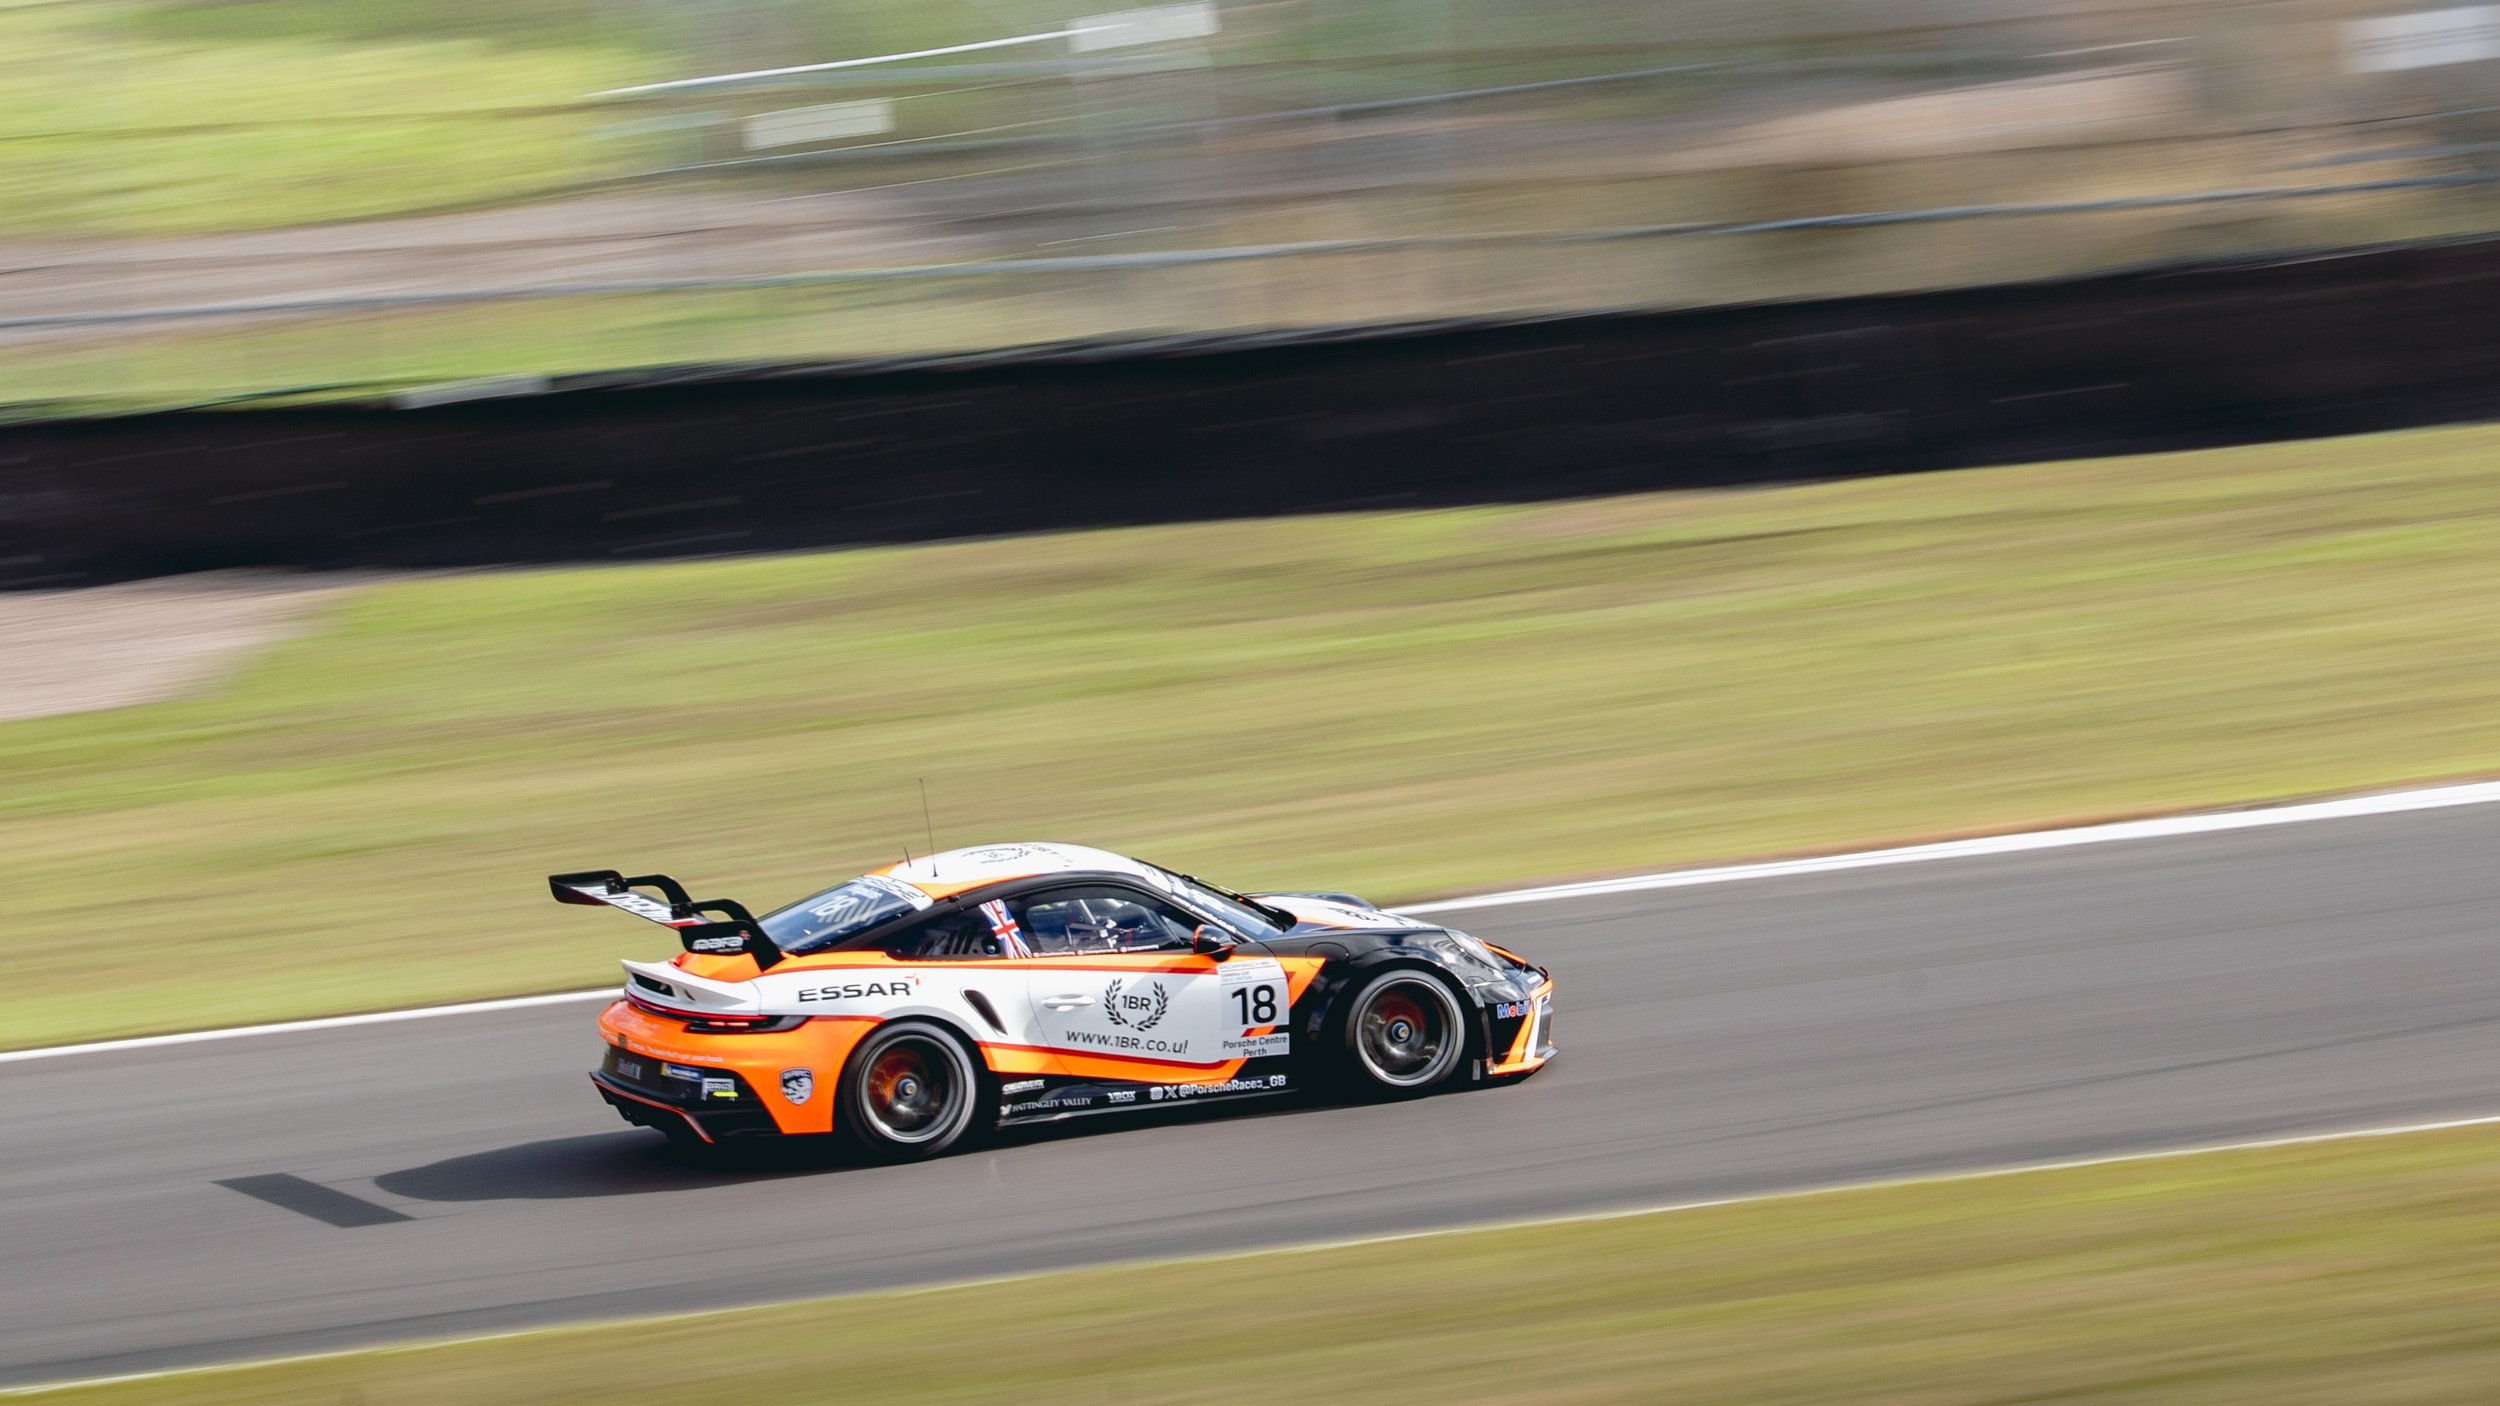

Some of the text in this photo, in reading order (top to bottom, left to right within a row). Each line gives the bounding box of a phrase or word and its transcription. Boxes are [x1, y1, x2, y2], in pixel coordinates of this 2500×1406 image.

[798, 982, 911, 1003] ESSAR
[1122, 995, 1152, 1012] 1BR
[1231, 984, 1277, 1025] 18
[1223, 1036, 1288, 1049] Porsche Centre
[1243, 1047, 1267, 1057] Perth
[1012, 1098, 1093, 1112] HATTINGLEY VALLEY
